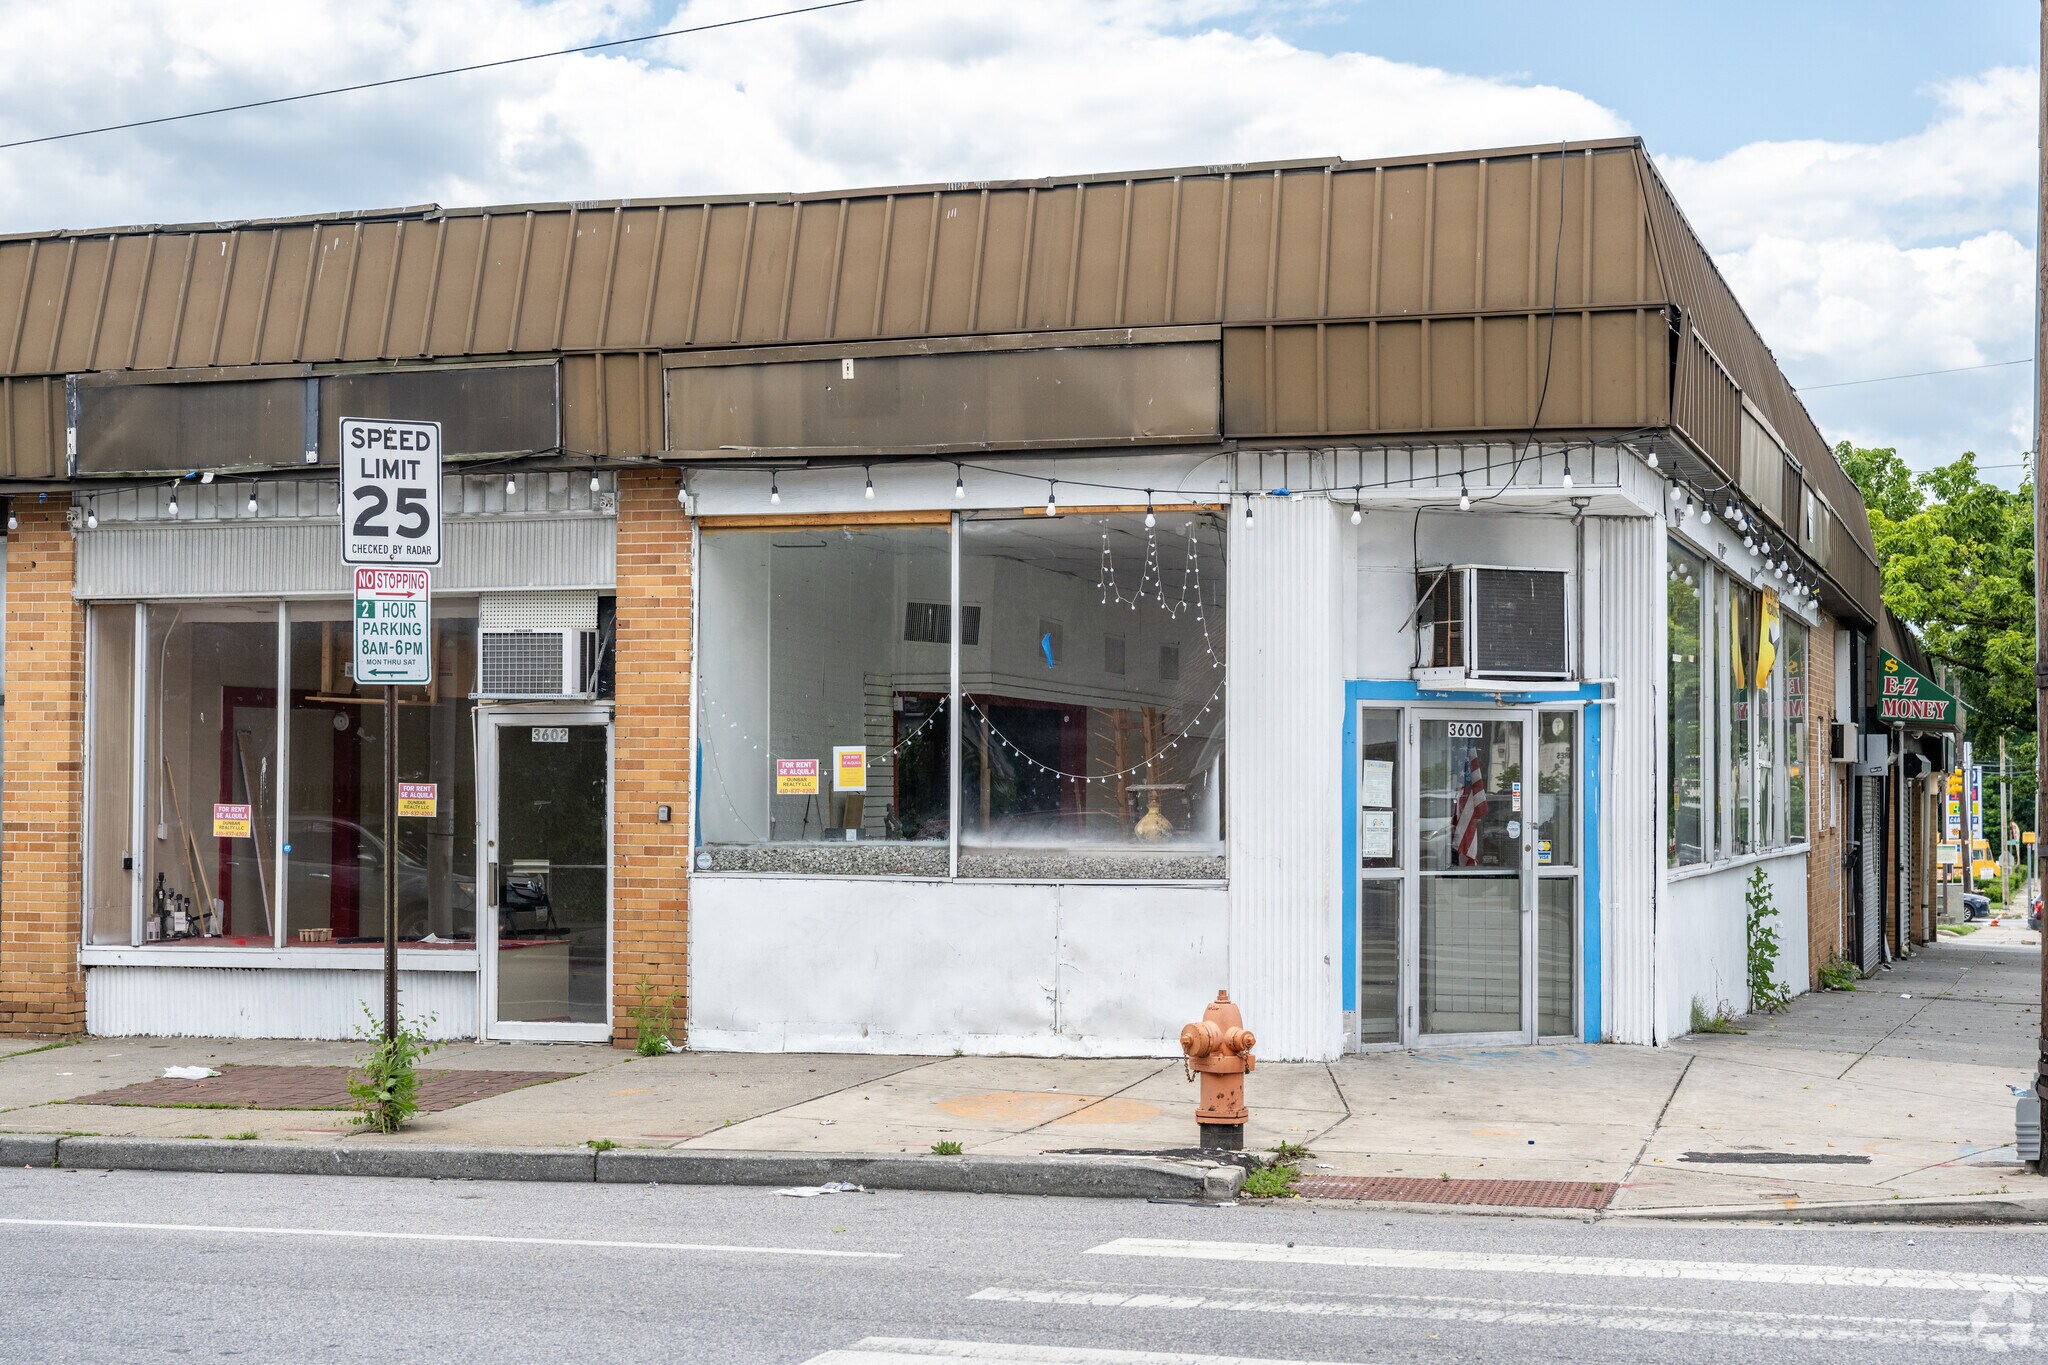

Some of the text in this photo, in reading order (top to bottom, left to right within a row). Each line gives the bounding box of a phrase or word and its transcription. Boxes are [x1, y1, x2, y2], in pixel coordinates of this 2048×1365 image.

[351, 427, 431, 451] SPEED
[361, 458, 421, 480] LIMIT
[352, 485, 430, 539] 25
[352, 543, 432, 555] CHECKED BY RADAR
[359, 571, 425, 590] NO STOPPING
[362, 601, 416, 619] 2 HOUR
[363, 622, 422, 636] PARKING
[362, 639, 423, 655] 8AM-6PM
[1885, 658, 1899, 674] $
[1883, 676, 1919, 696] E-Z
[1881, 698, 1949, 720] MONEY
[533, 729, 568, 741] 3602
[1449, 723, 1481, 737] 3600
